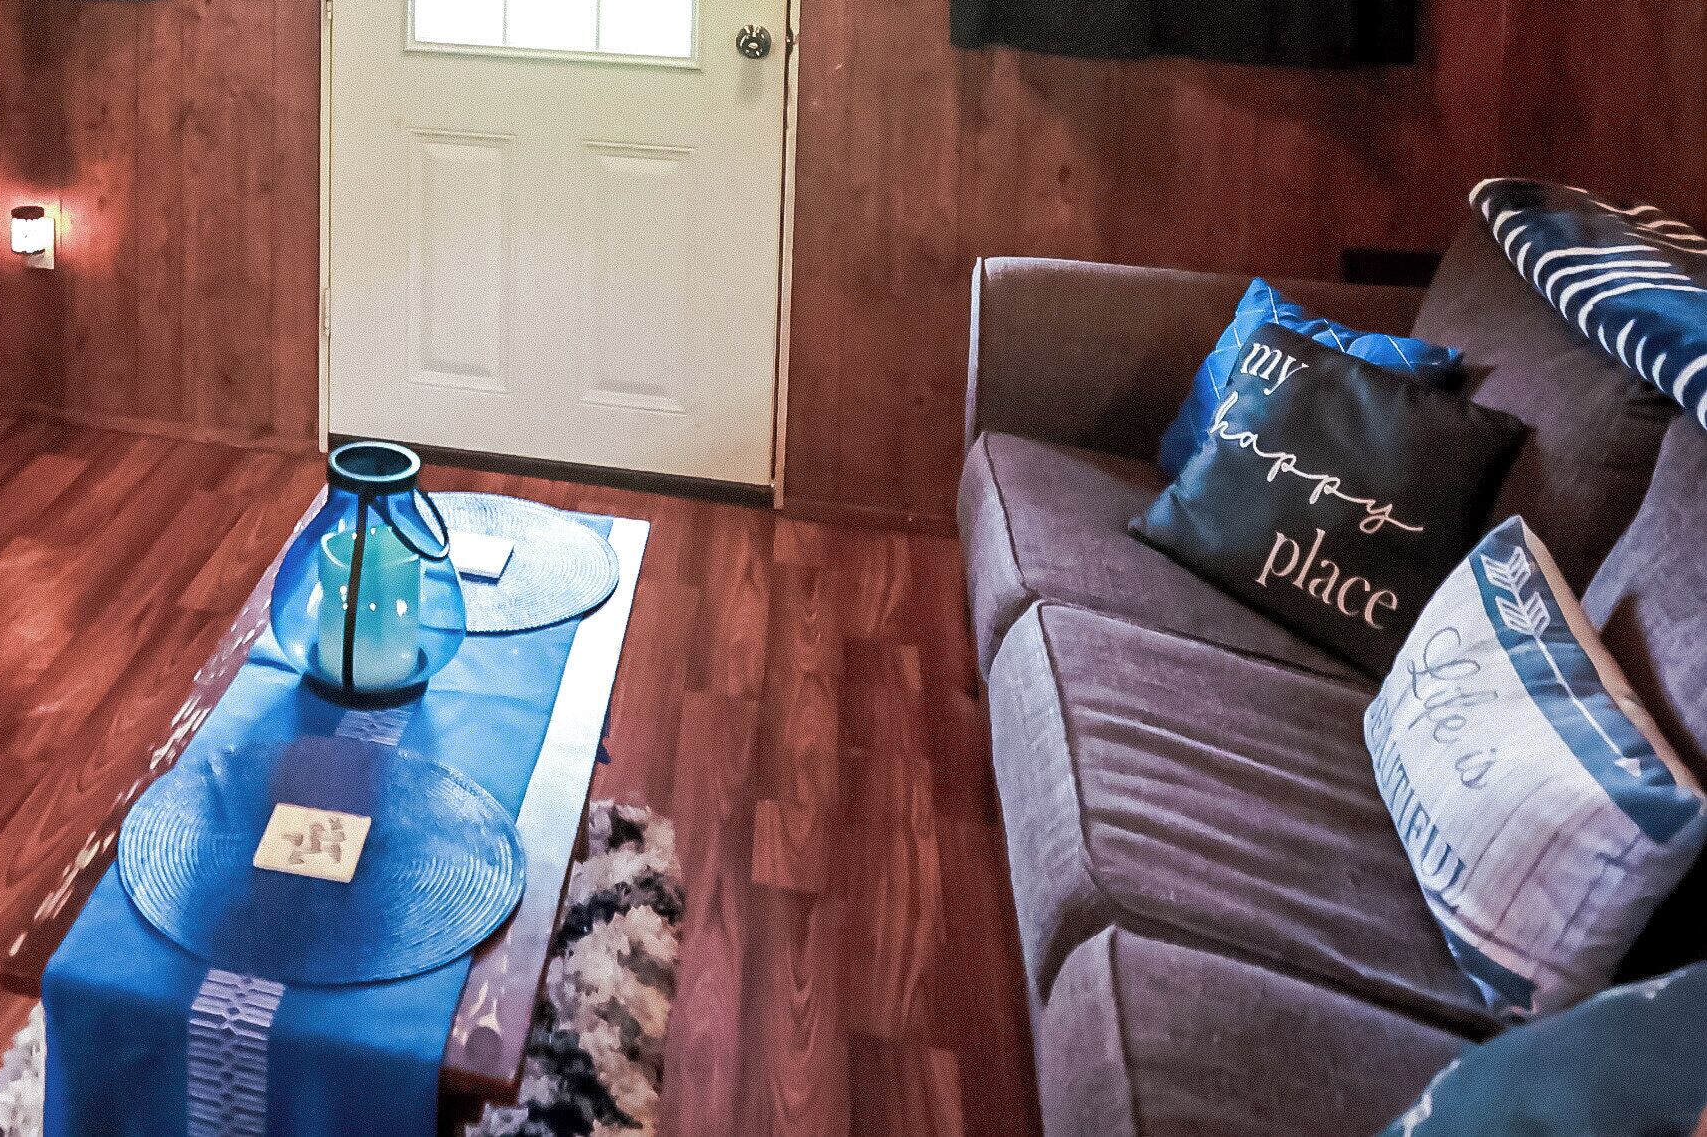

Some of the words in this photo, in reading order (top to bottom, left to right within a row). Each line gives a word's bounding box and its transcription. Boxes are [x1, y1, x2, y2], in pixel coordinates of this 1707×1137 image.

[1239, 341, 1310, 396] my
[1209, 391, 1424, 534] happy
[1255, 528, 1398, 630] place
[1407, 626, 1499, 744] Life
[1454, 747, 1496, 790] is
